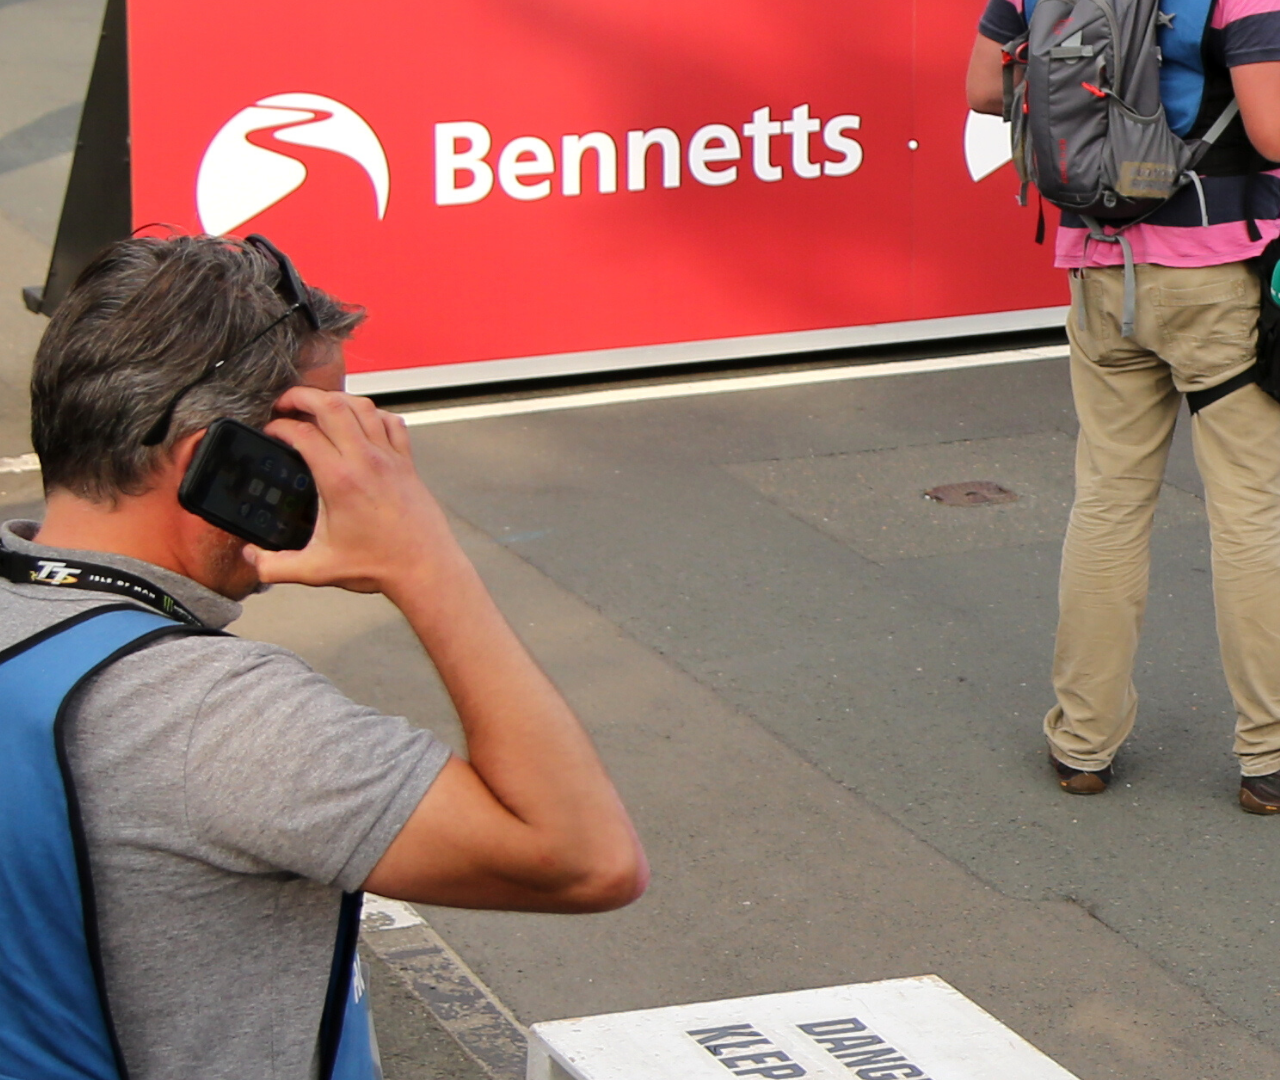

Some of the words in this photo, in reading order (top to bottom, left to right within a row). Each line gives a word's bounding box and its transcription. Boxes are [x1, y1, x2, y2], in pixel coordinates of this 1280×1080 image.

[434, 102, 865, 207] Bennetts
[37, 560, 82, 586] TT
[89, 574, 113, 584] ISLE
[117, 579, 130, 588] OF
[134, 585, 156, 599] MAN
[795, 1017, 938, 1080] DANG
